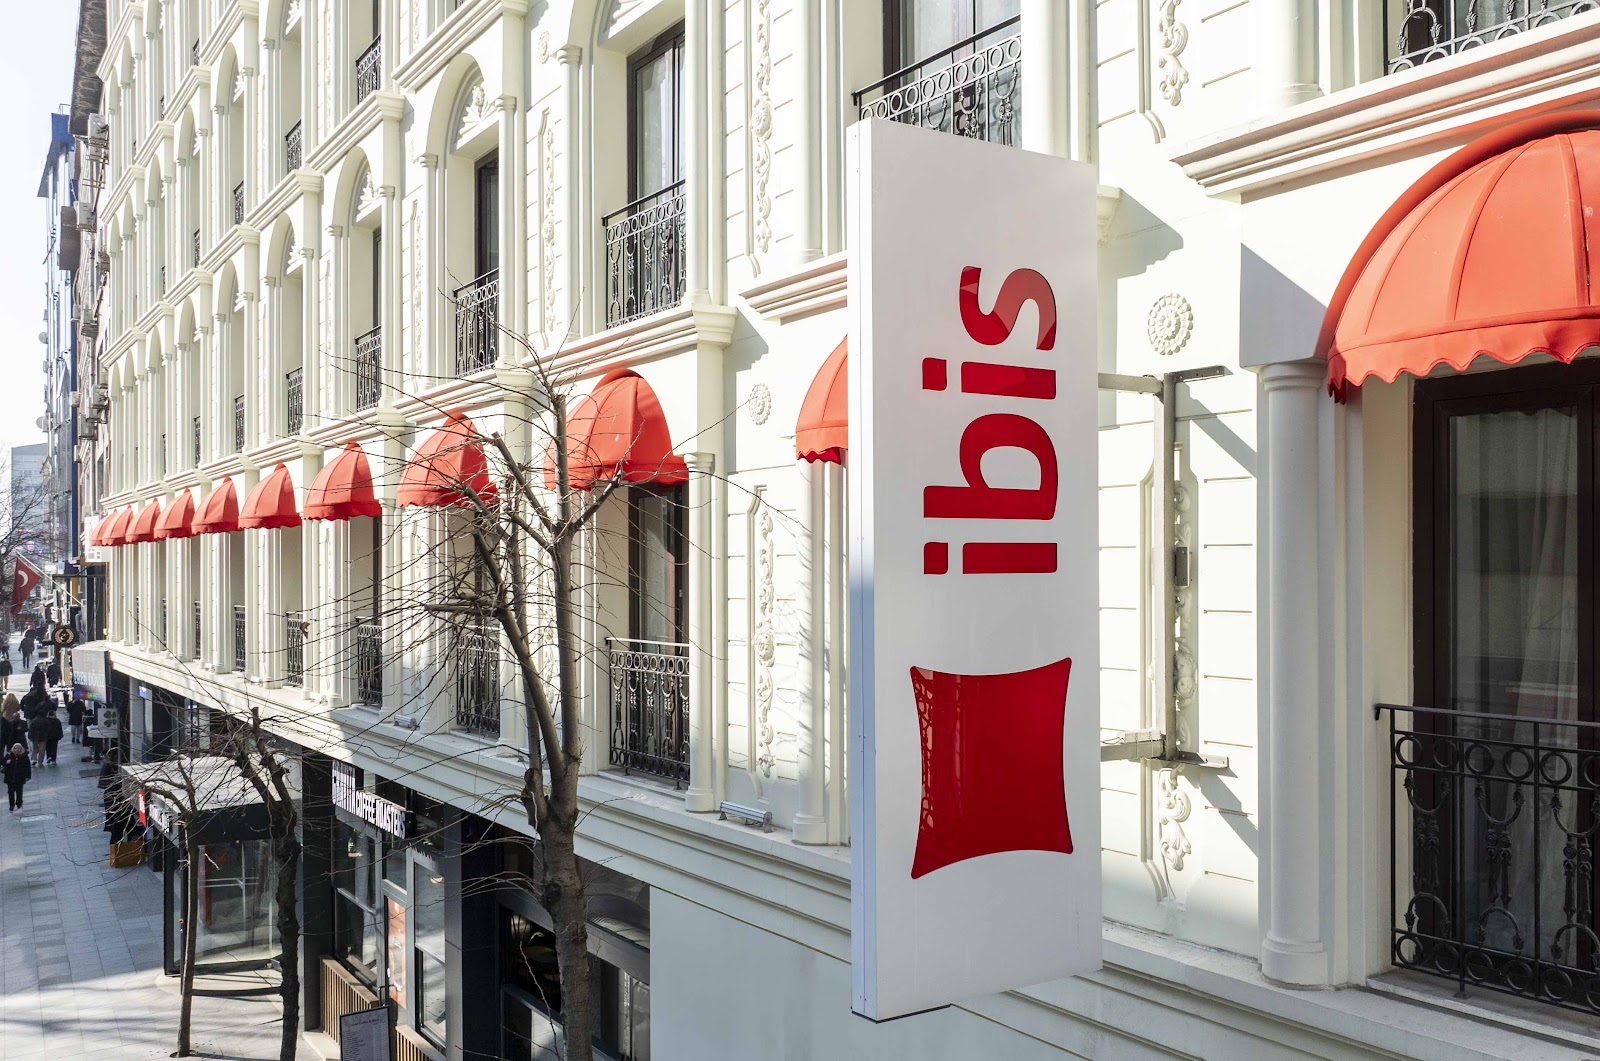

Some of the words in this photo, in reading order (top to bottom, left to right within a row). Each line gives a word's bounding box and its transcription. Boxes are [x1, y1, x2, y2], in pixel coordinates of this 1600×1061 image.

[922, 266, 1058, 574] ibis
[356, 790, 376, 825] COFFEE
[376, 799, 406, 840] ROASTERS
